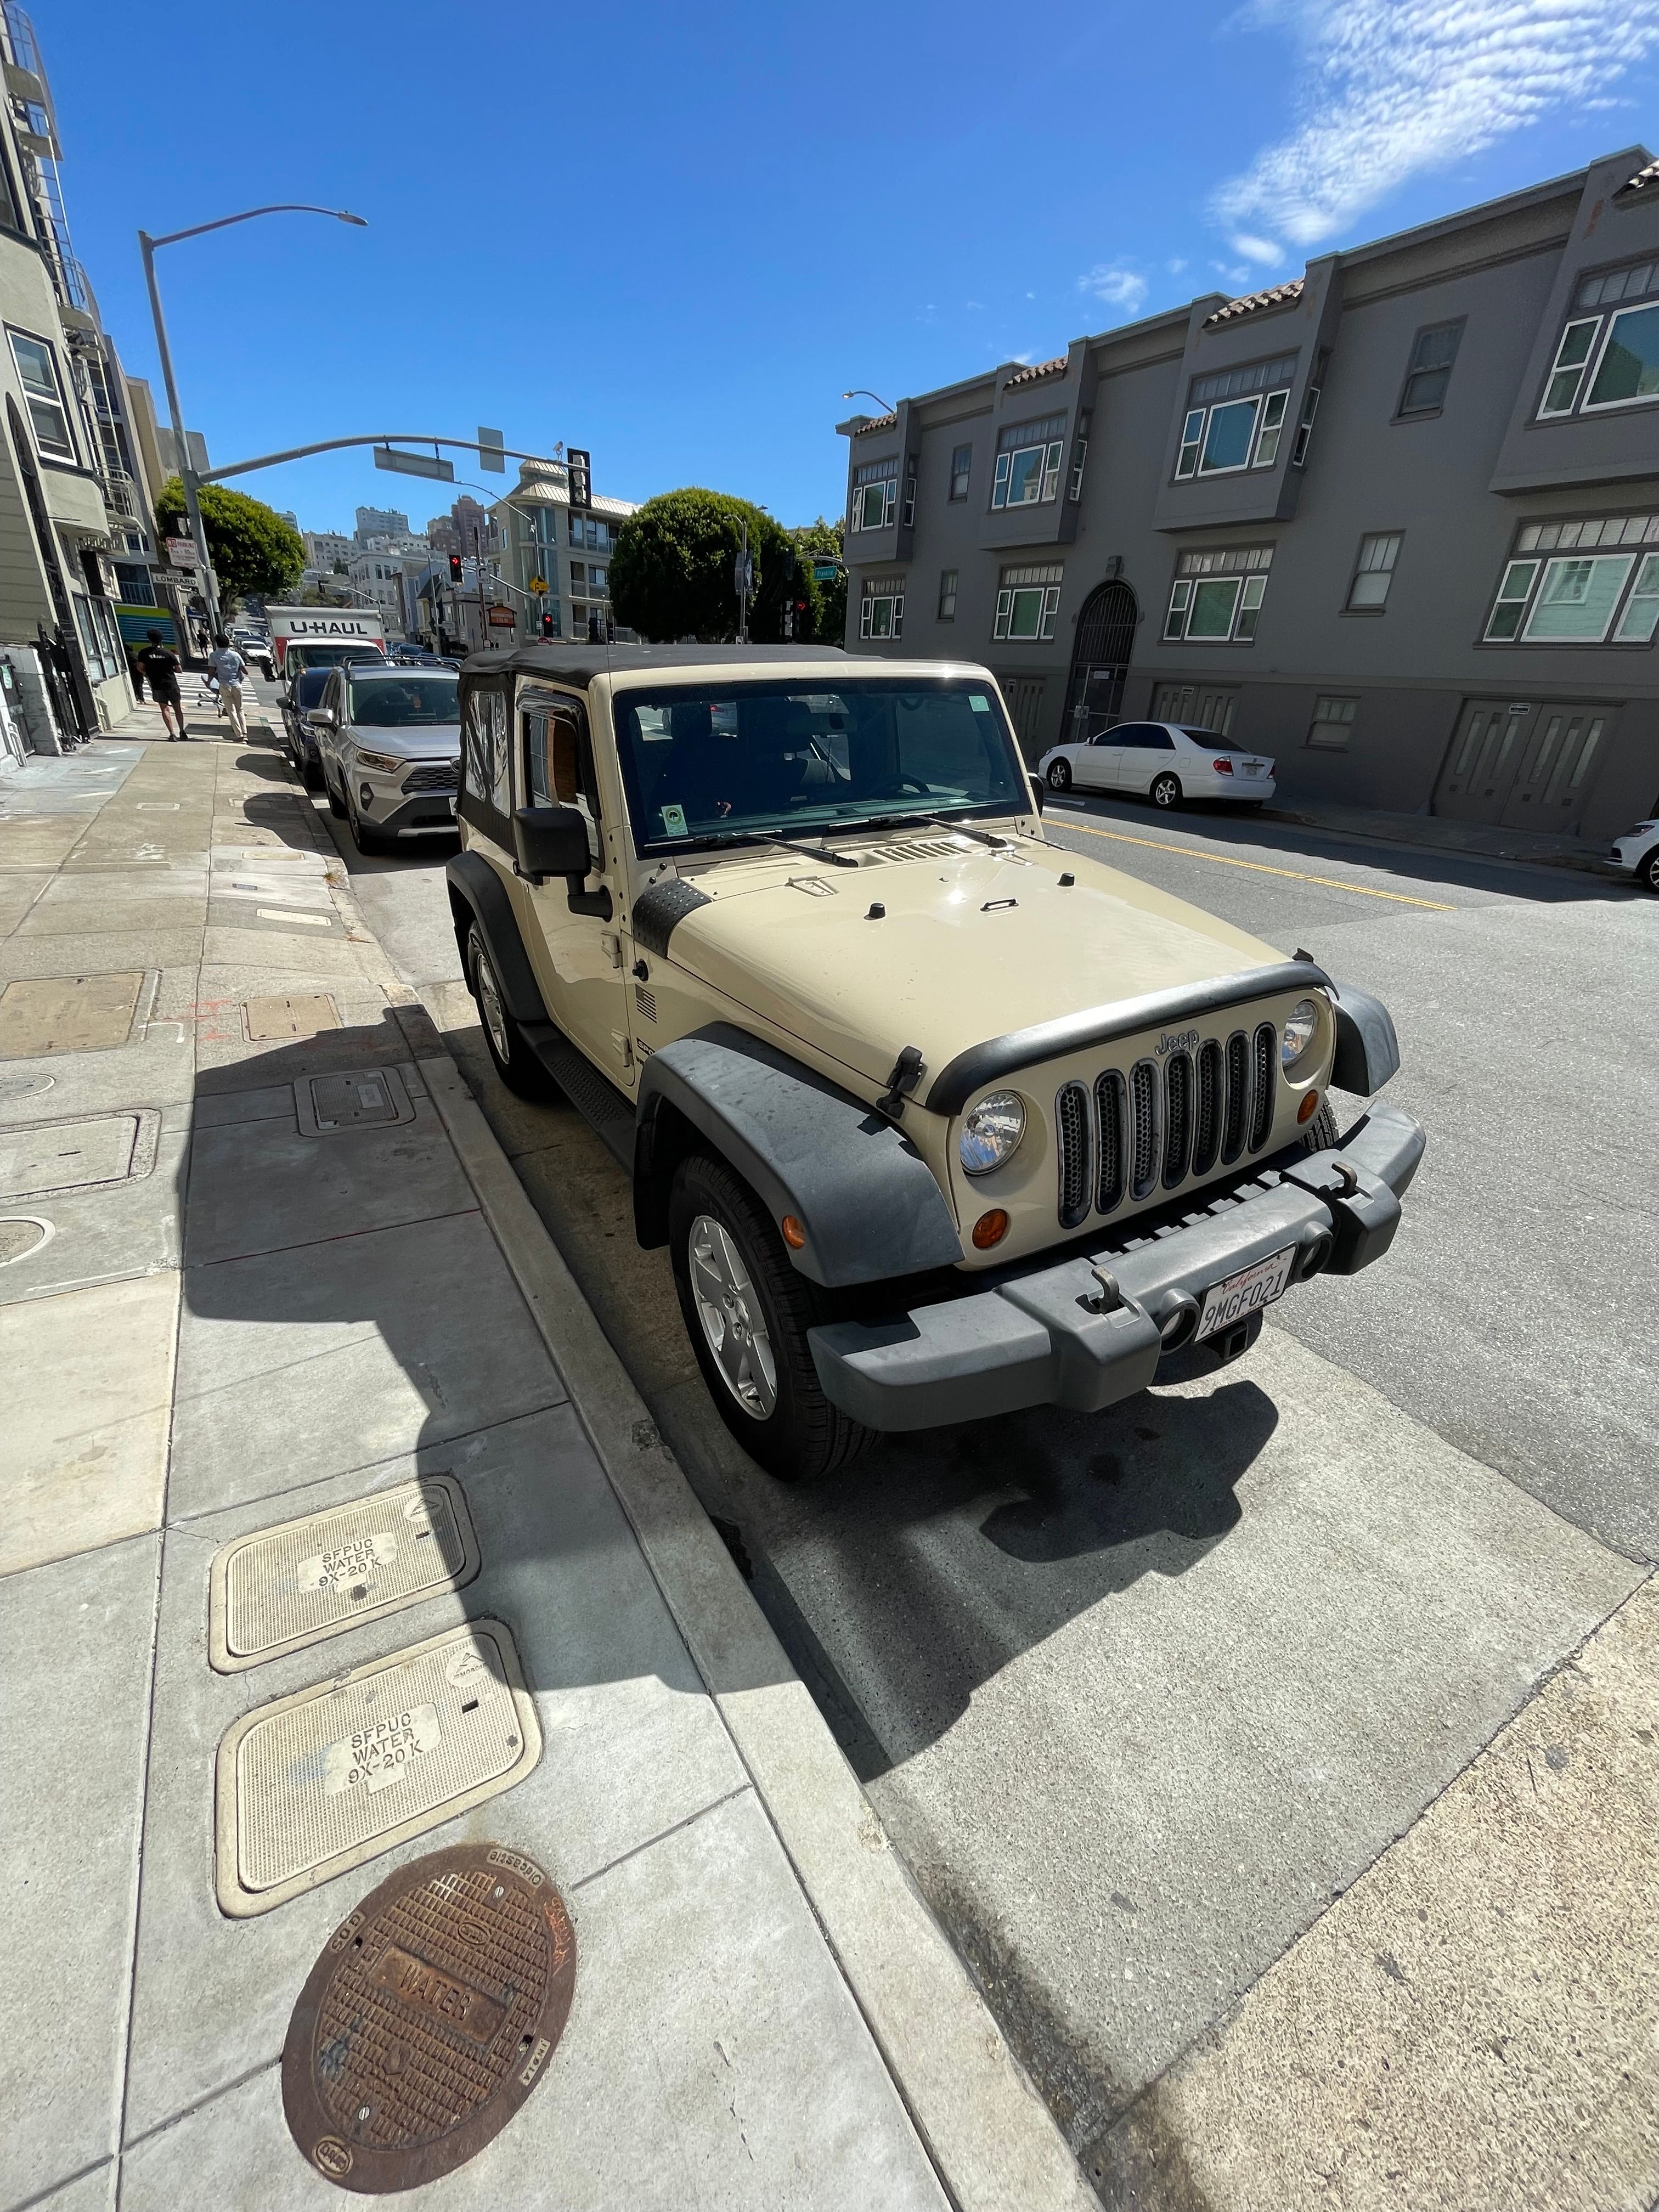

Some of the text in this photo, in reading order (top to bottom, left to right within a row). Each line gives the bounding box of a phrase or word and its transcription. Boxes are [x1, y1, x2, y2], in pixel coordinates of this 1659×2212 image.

[155, 575, 196, 585] LOMBARD
[290, 620, 368, 635] U-HAUL
[1154, 1029, 1199, 1056] Jeep
[1222, 1263, 1278, 1295] California
[1200, 1269, 1284, 1335] 9MGF021
[321, 1538, 373, 1564] SFPUC
[323, 1548, 375, 1573] WATER
[351, 1712, 411, 1749] SFPUC
[352, 1728, 415, 1765] WATER
[490, 1851, 542, 1886] Oldcastle
[400, 1964, 472, 2021] WATER
